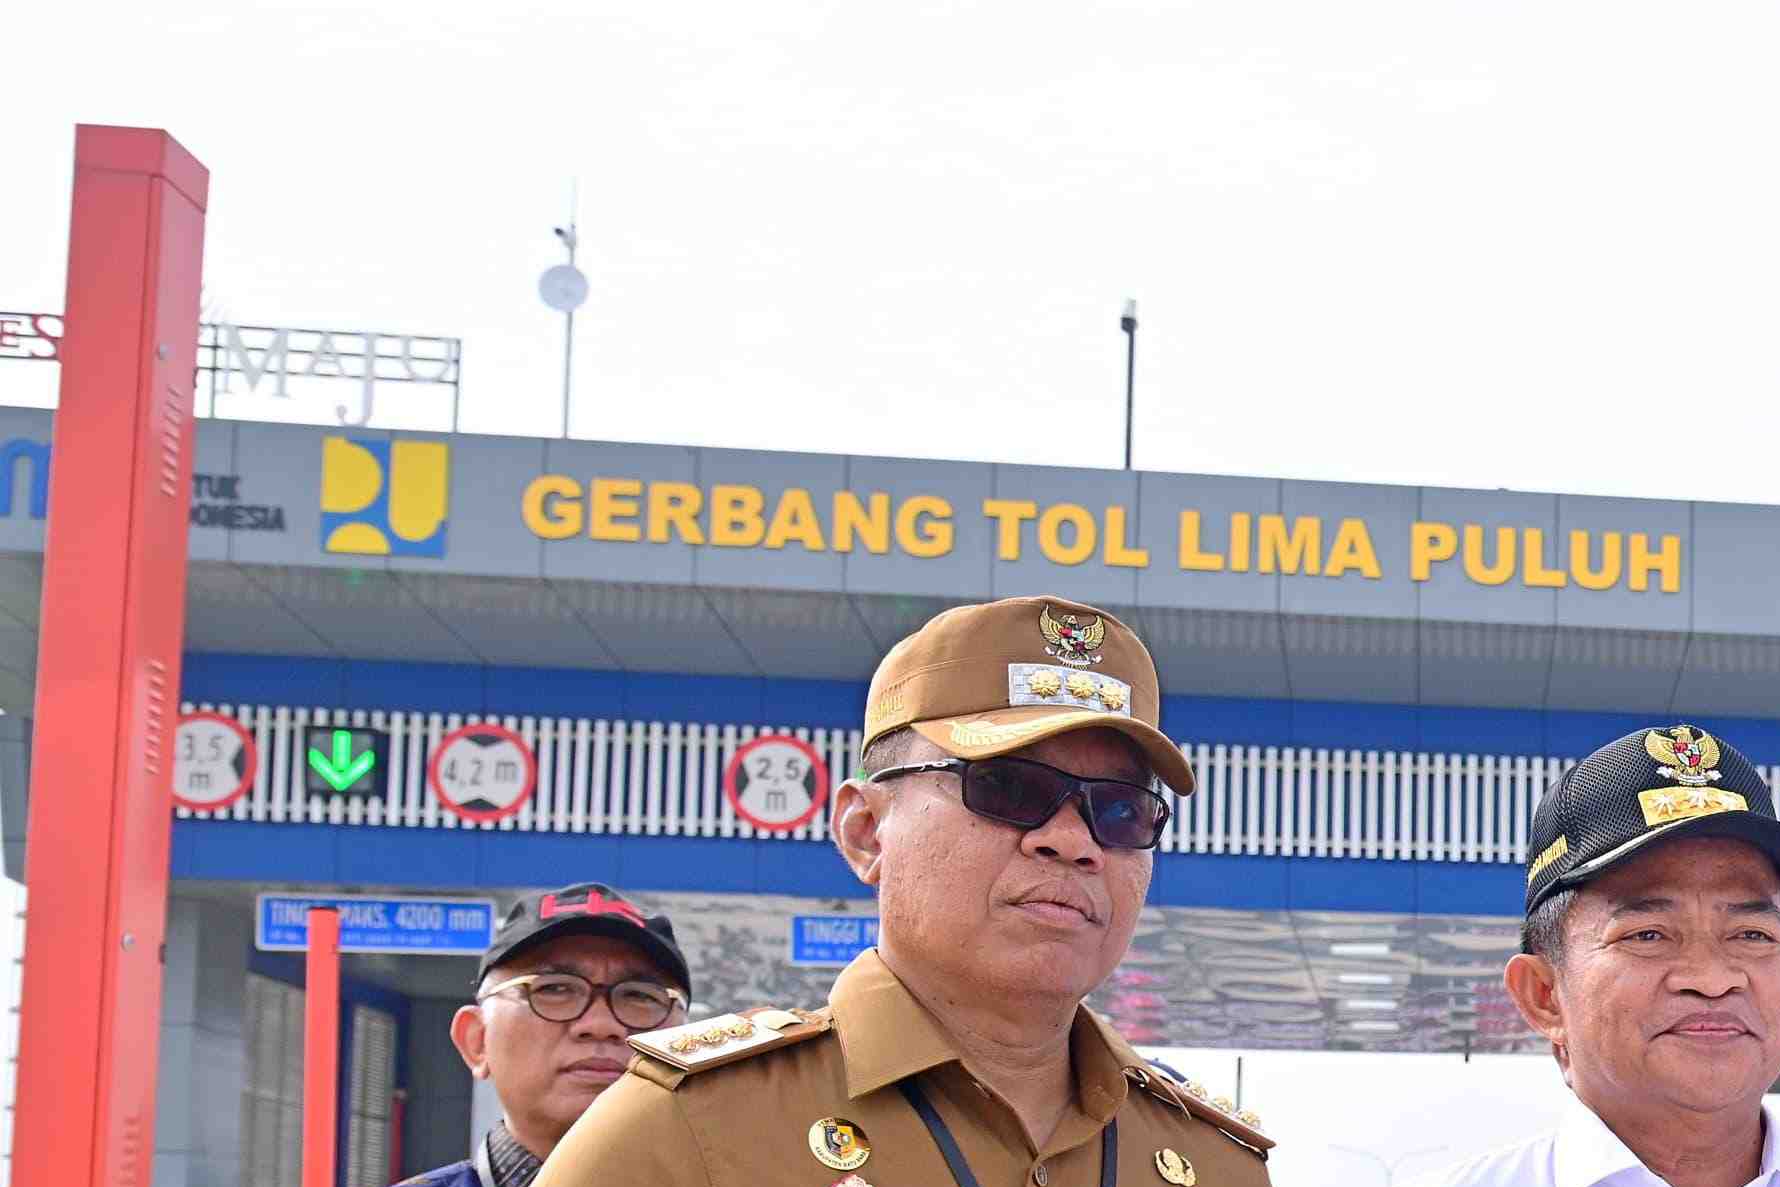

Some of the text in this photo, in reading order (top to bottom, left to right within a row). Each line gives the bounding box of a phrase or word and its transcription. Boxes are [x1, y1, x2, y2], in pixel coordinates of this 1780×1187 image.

[217, 325, 454, 427] MAJU
[524, 476, 1682, 594] GERBANG TOL LIMA PULUH
[189, 770, 211, 790] m
[495, 760, 518, 783] m
[755, 757, 802, 785] 2,5
[765, 790, 788, 812] m
[395, 904, 444, 930] 4200
[448, 909, 488, 931] mm
